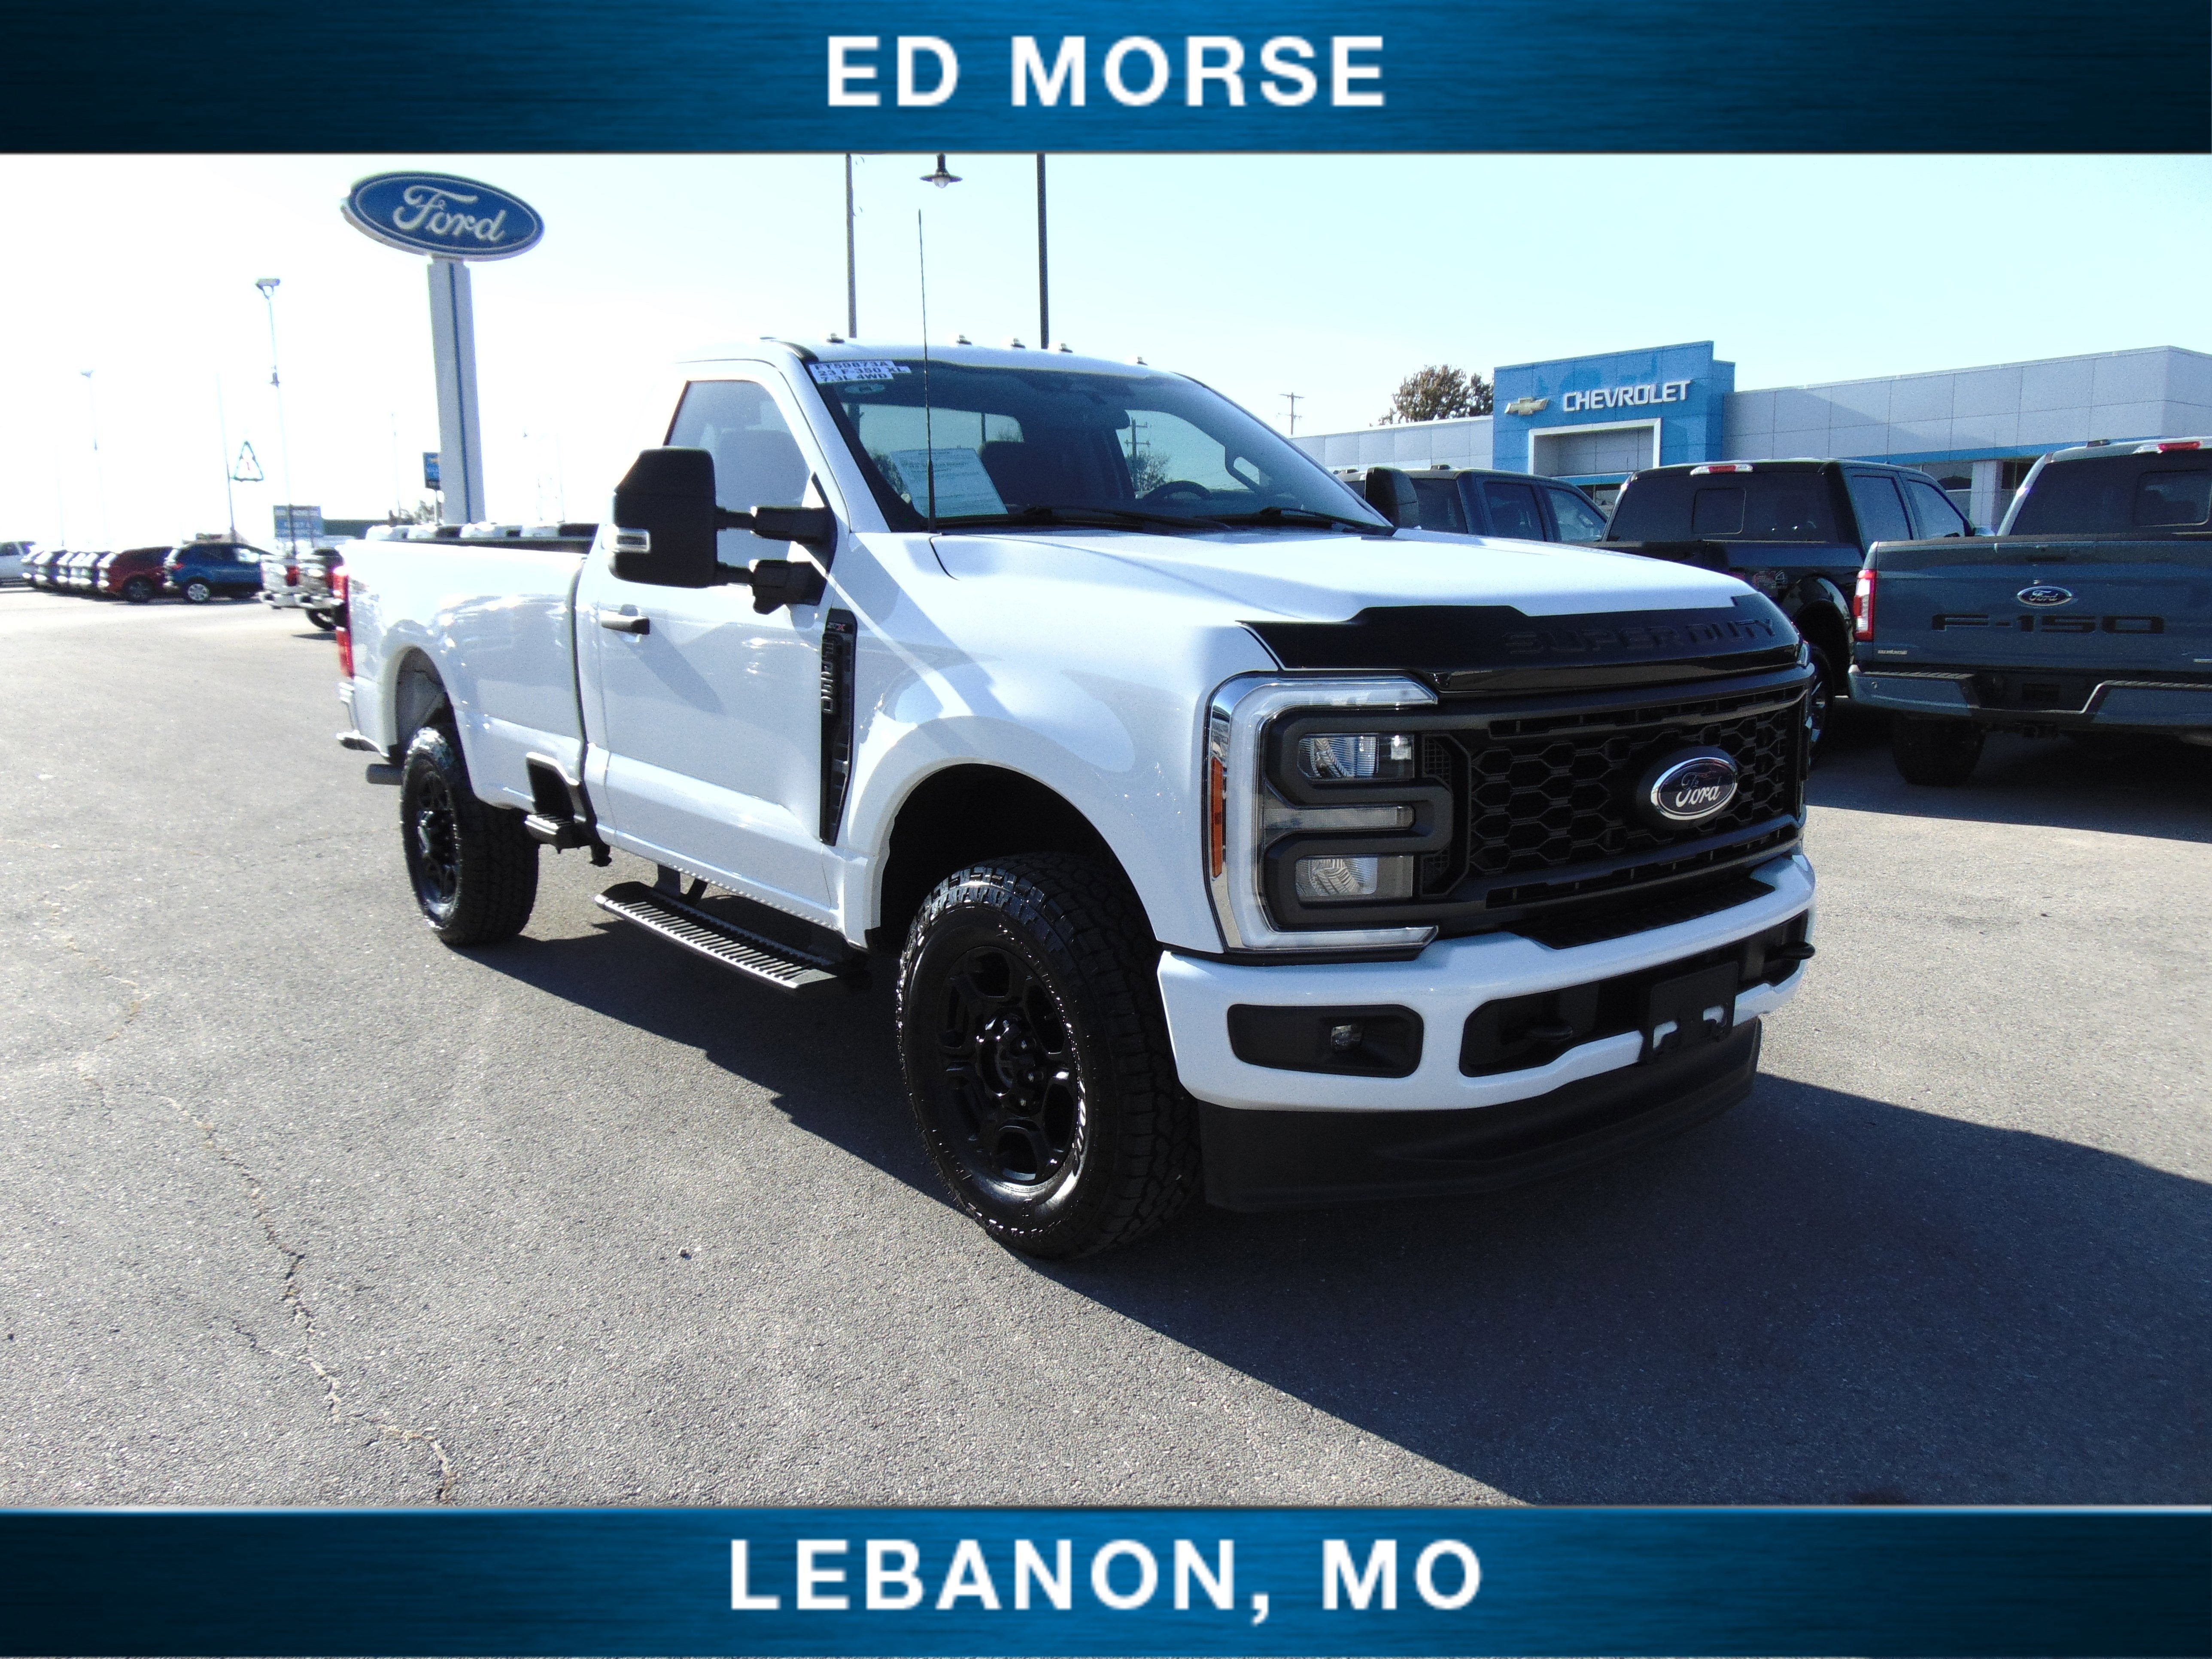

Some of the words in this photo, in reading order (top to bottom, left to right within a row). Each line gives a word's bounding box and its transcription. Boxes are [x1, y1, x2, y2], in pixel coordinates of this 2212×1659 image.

[392, 185, 507, 242] Ford
[1563, 380, 1691, 412] CHEVROLET
[2029, 590, 2058, 602] Ford
[1502, 627, 1683, 653] SUPER
[1685, 618, 1775, 643] DUTY
[1932, 614, 2165, 634] F-150
[1676, 772, 1723, 808] Ford
